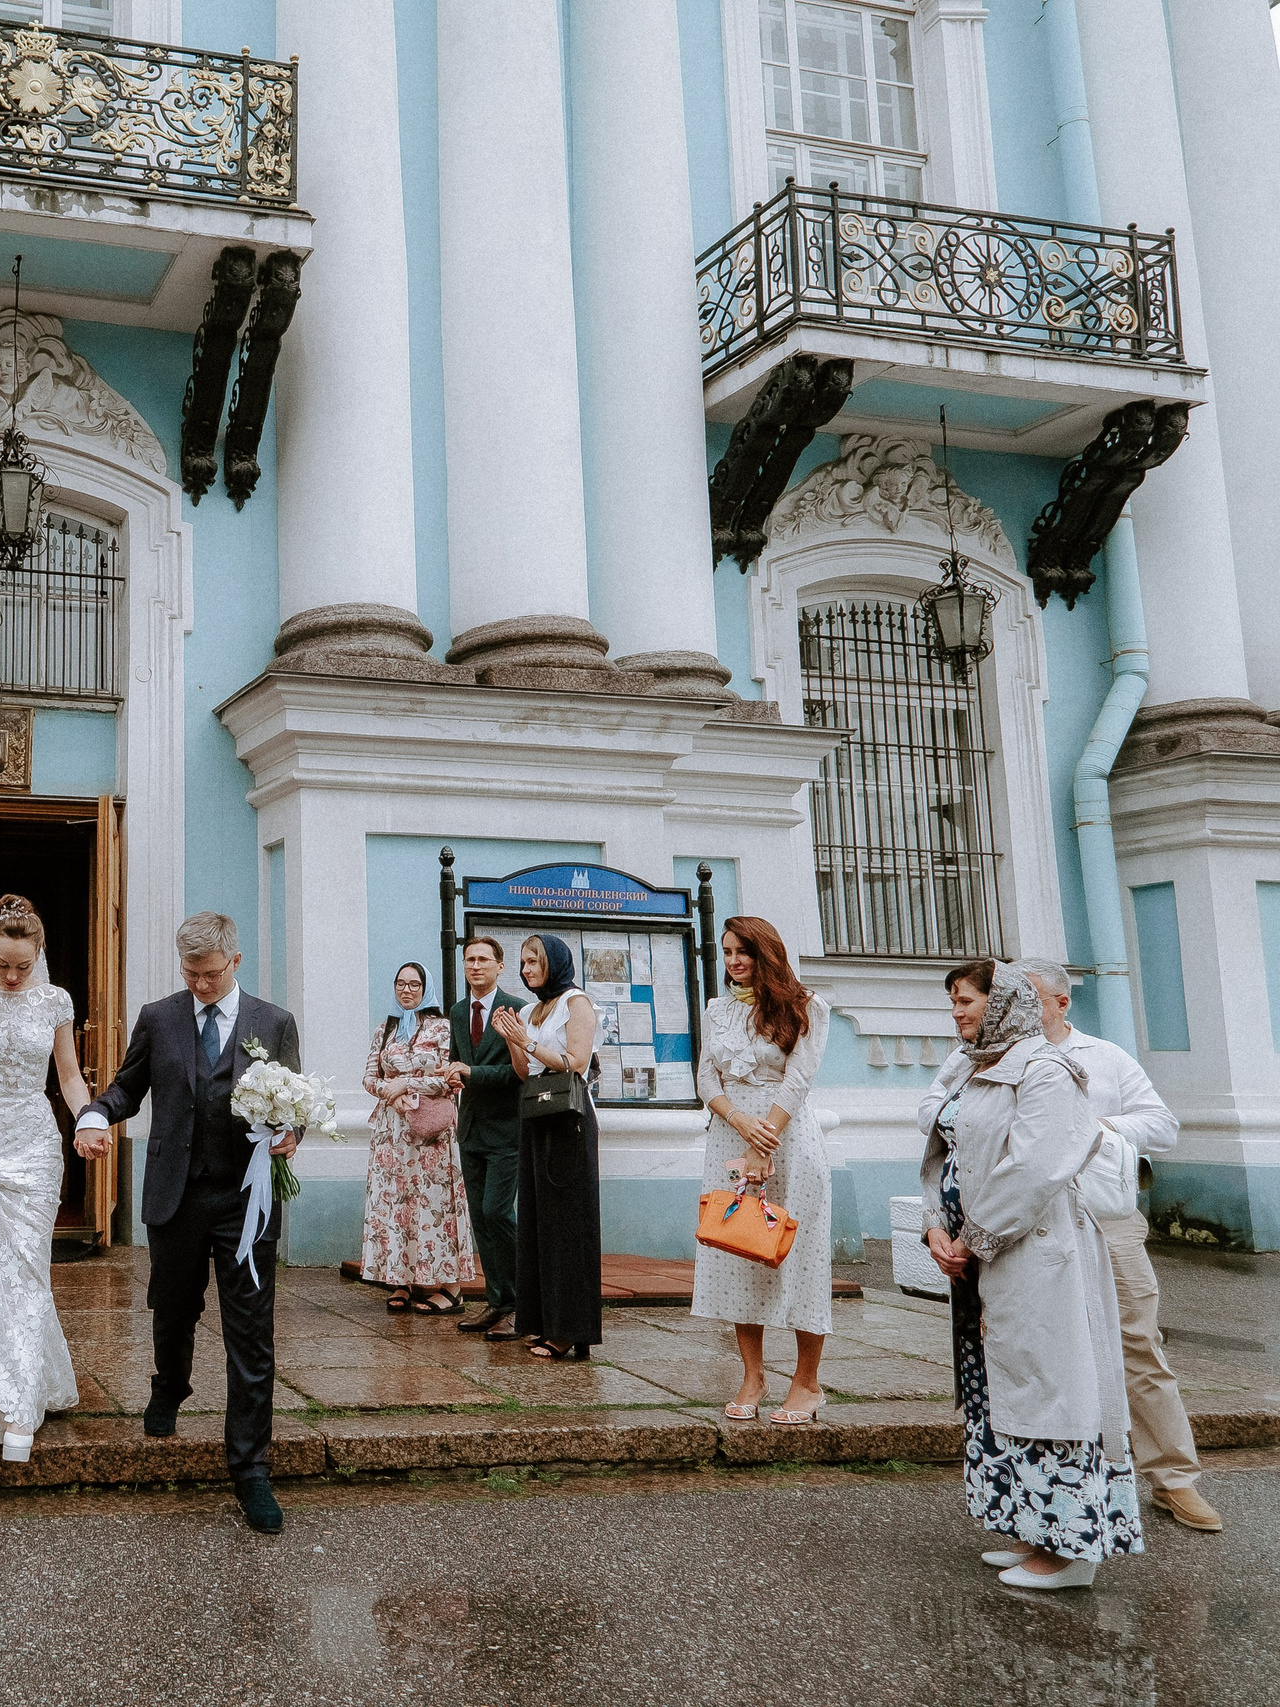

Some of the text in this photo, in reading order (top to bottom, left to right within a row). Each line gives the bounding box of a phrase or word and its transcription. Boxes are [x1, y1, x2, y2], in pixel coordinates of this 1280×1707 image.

[509, 885, 648, 901] НИКОЛО-БОГОЯВЛЕНСКИЙ
[532, 898, 623, 911] МОРСКОЙ СОБОР
